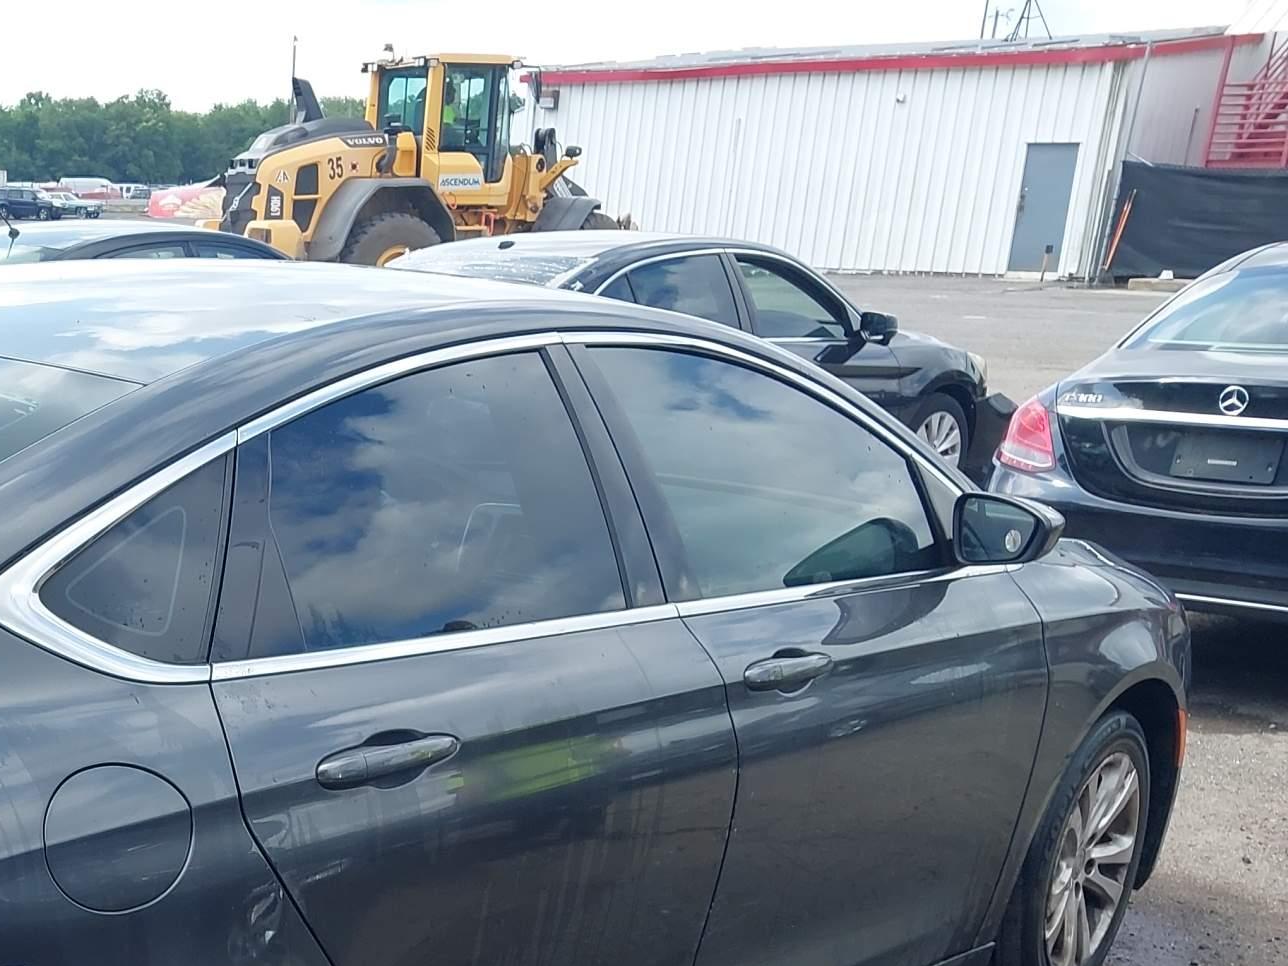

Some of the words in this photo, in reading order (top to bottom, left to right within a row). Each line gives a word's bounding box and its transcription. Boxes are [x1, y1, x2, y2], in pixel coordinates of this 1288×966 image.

[347, 137, 383, 145] VOLVO
[327, 156, 344, 180] 35
[440, 177, 480, 186] ASCENDUM
